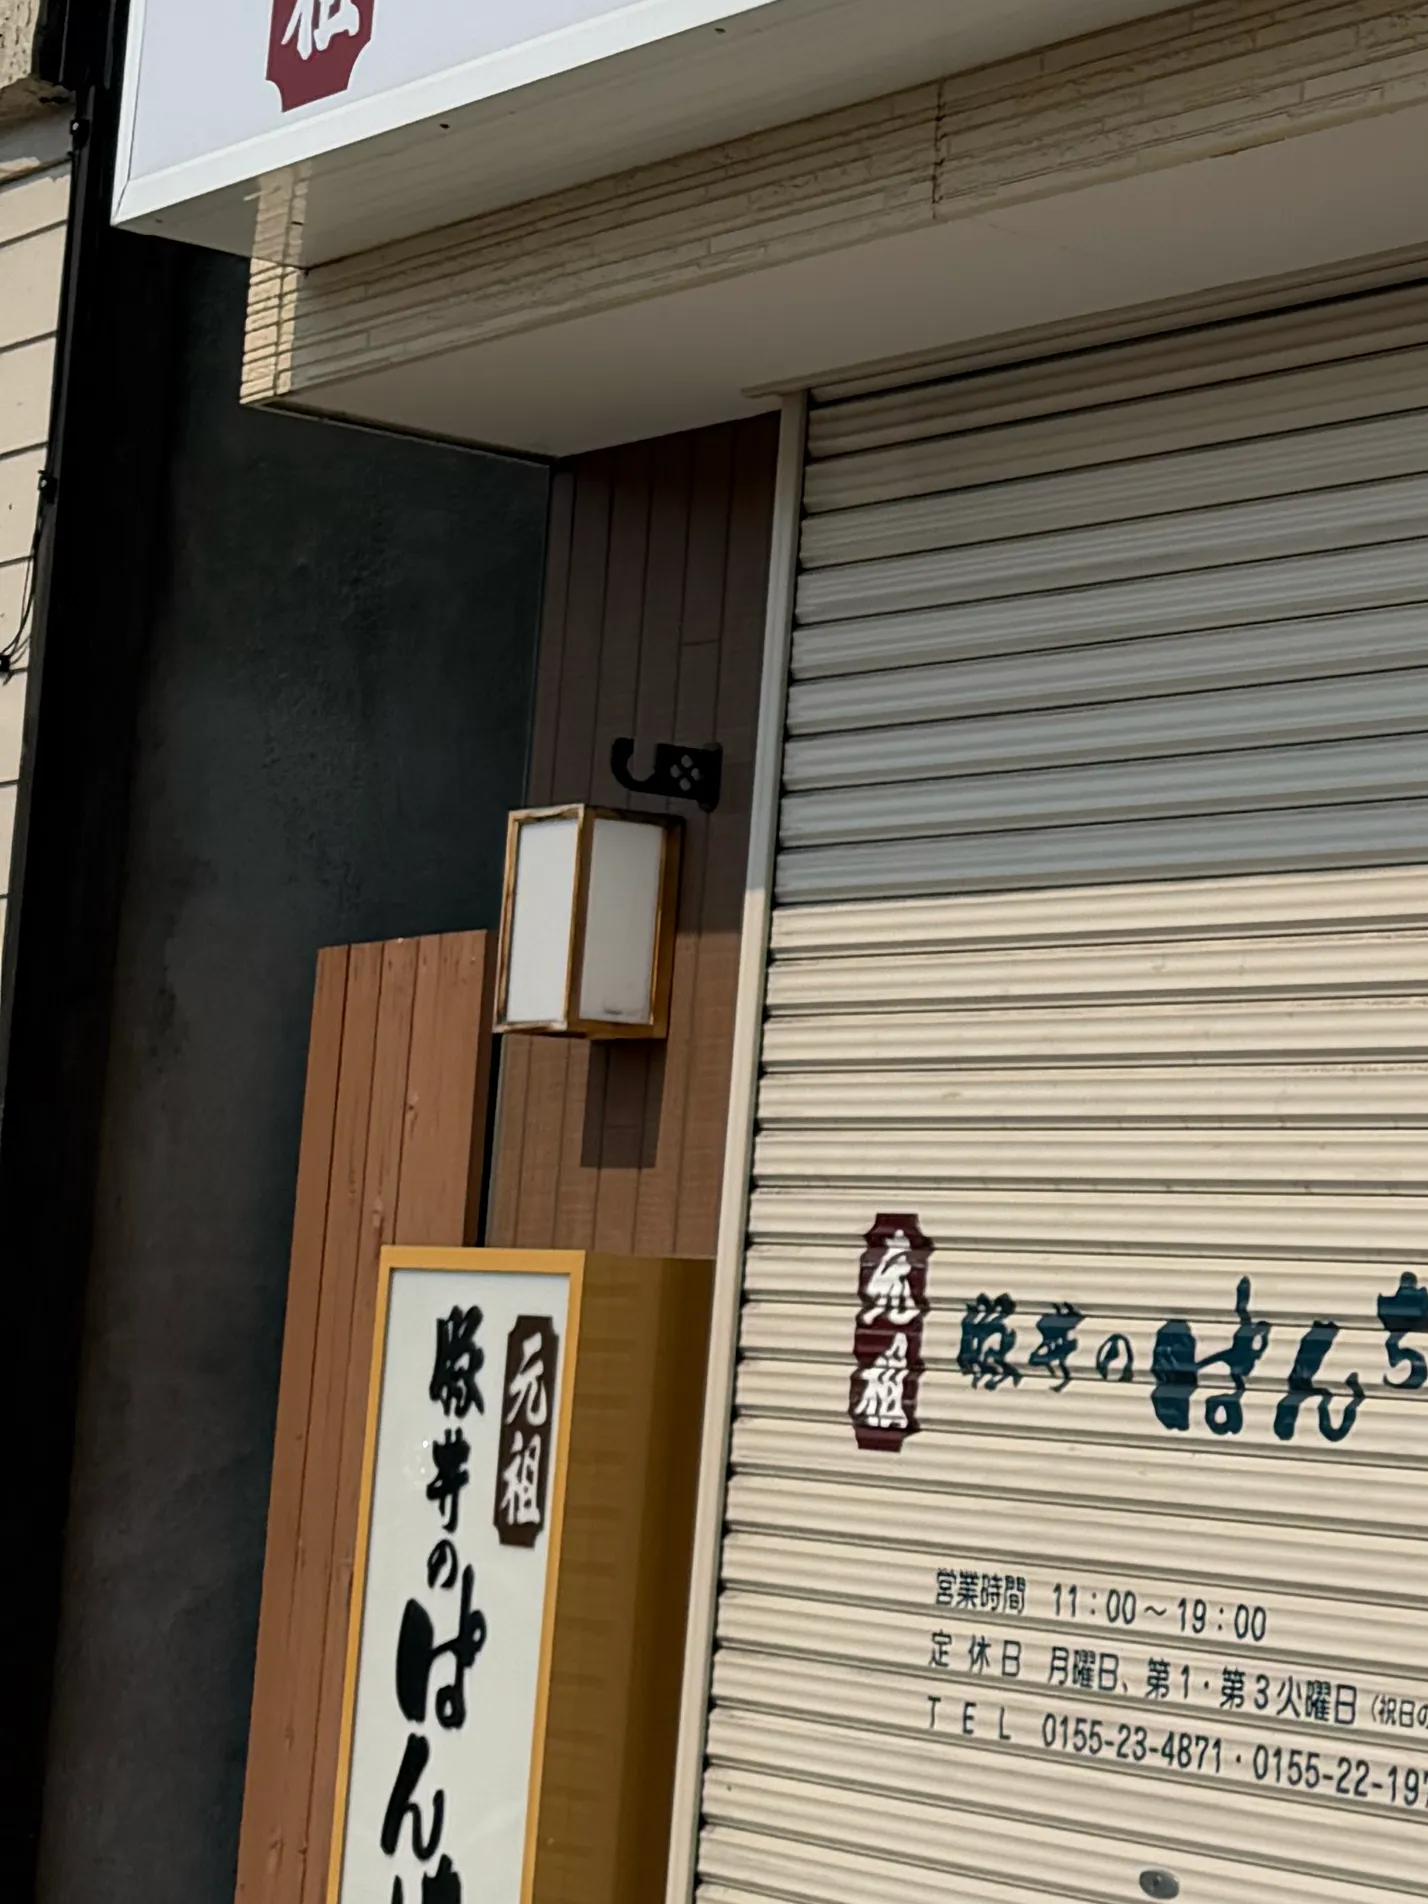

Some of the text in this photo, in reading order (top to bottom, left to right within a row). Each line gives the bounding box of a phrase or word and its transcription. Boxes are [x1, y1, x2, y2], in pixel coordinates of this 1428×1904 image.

[501, 1331, 547, 1525] 元祖
[935, 1567, 1026, 1615] 営業時間
